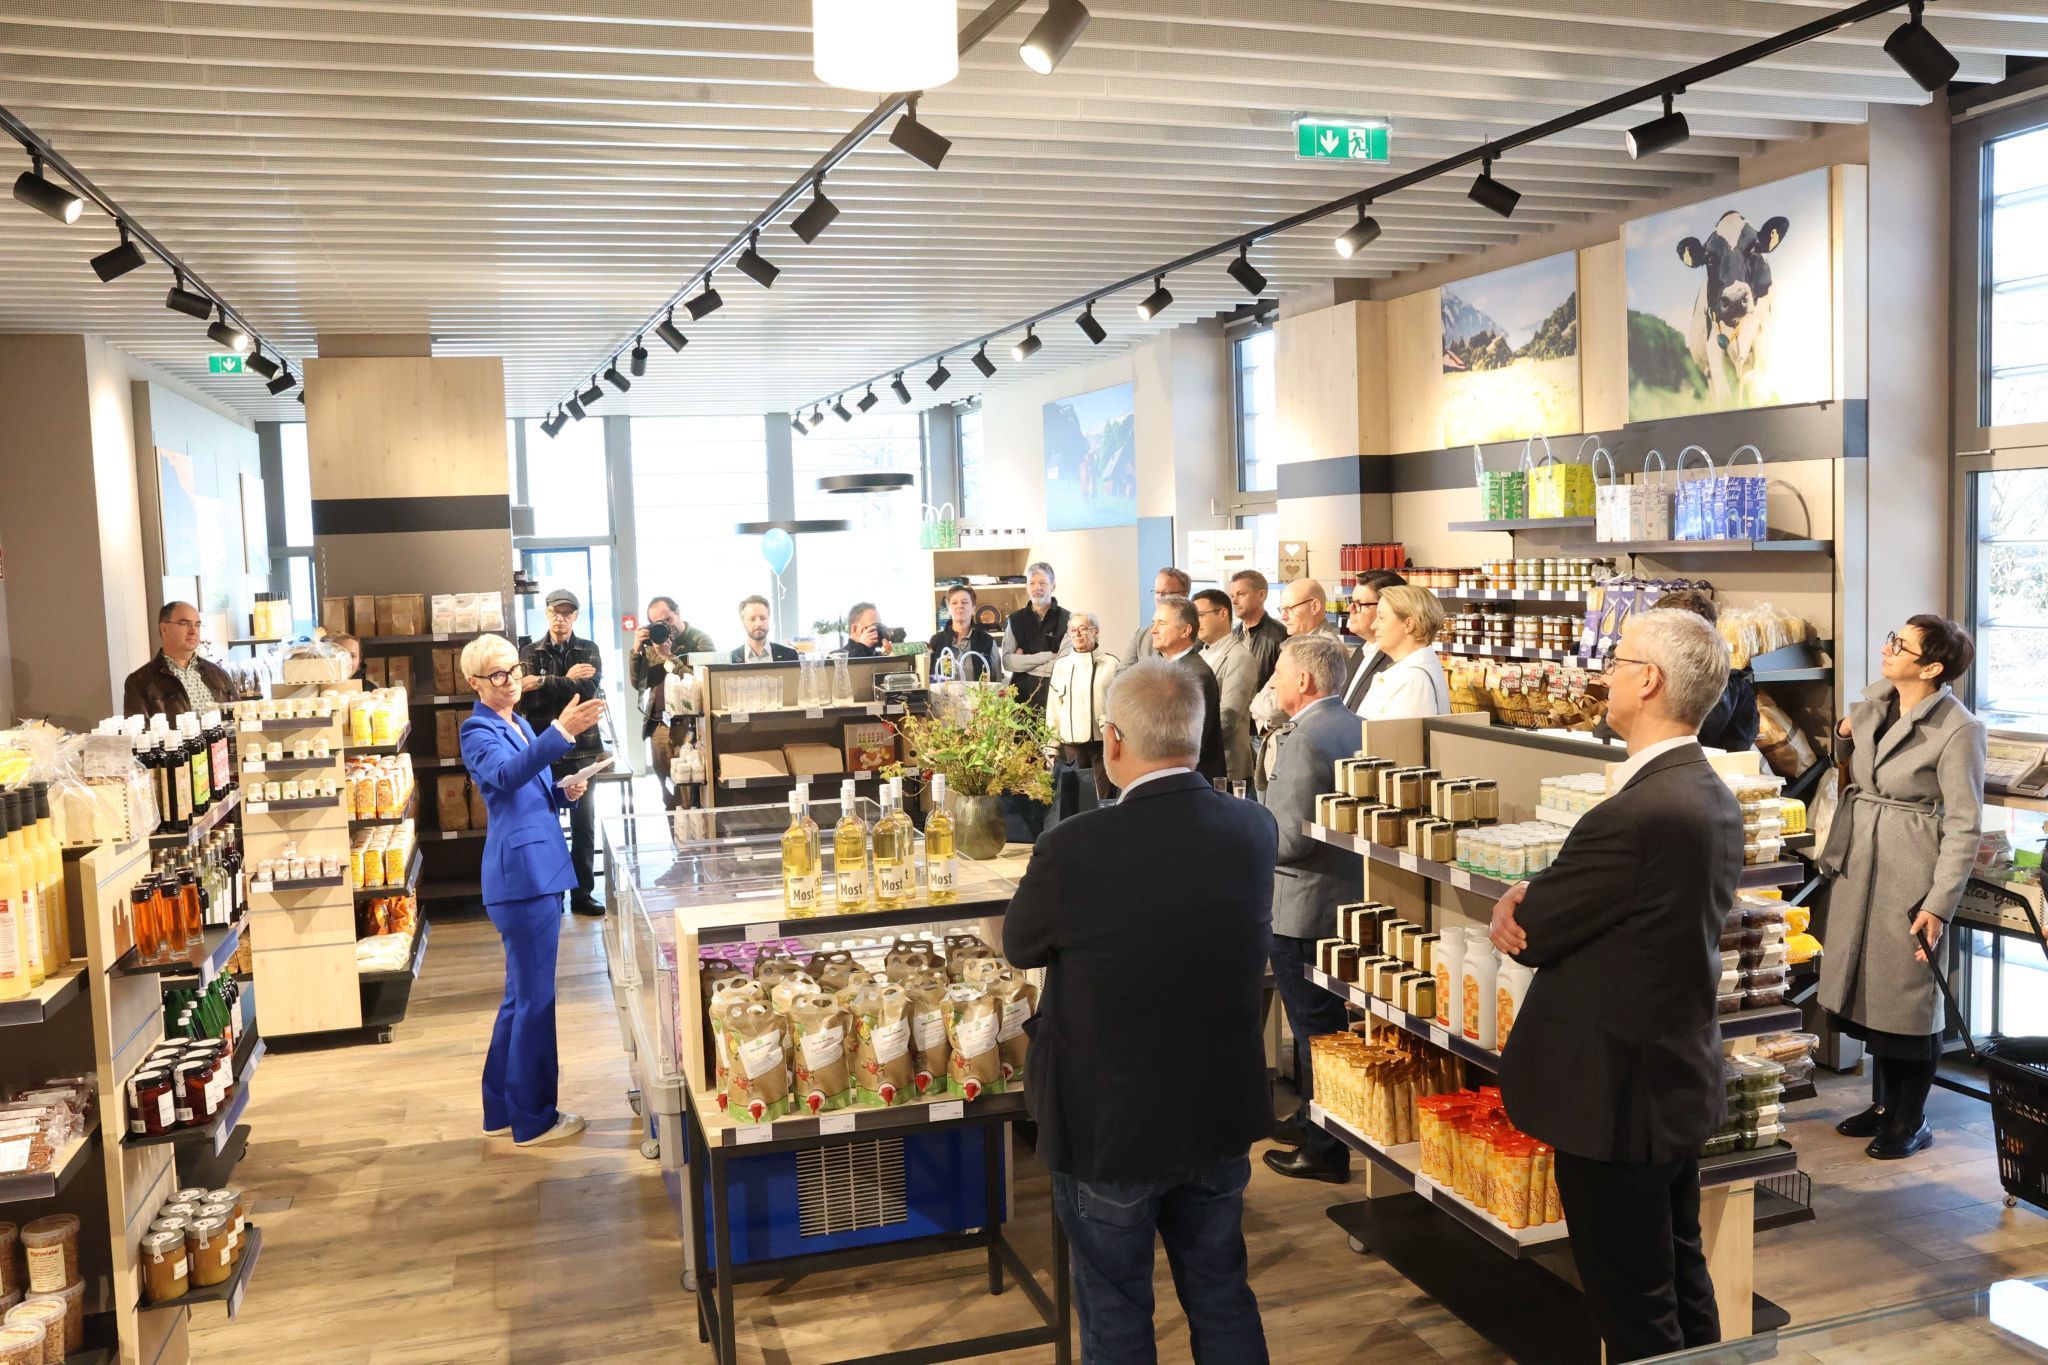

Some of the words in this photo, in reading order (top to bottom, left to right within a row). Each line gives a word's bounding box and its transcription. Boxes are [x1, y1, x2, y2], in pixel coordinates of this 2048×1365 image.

[881, 878, 904, 891] Most
[930, 872, 953, 886] Most
[793, 888, 815, 902] Most
[840, 883, 863, 896] Most
